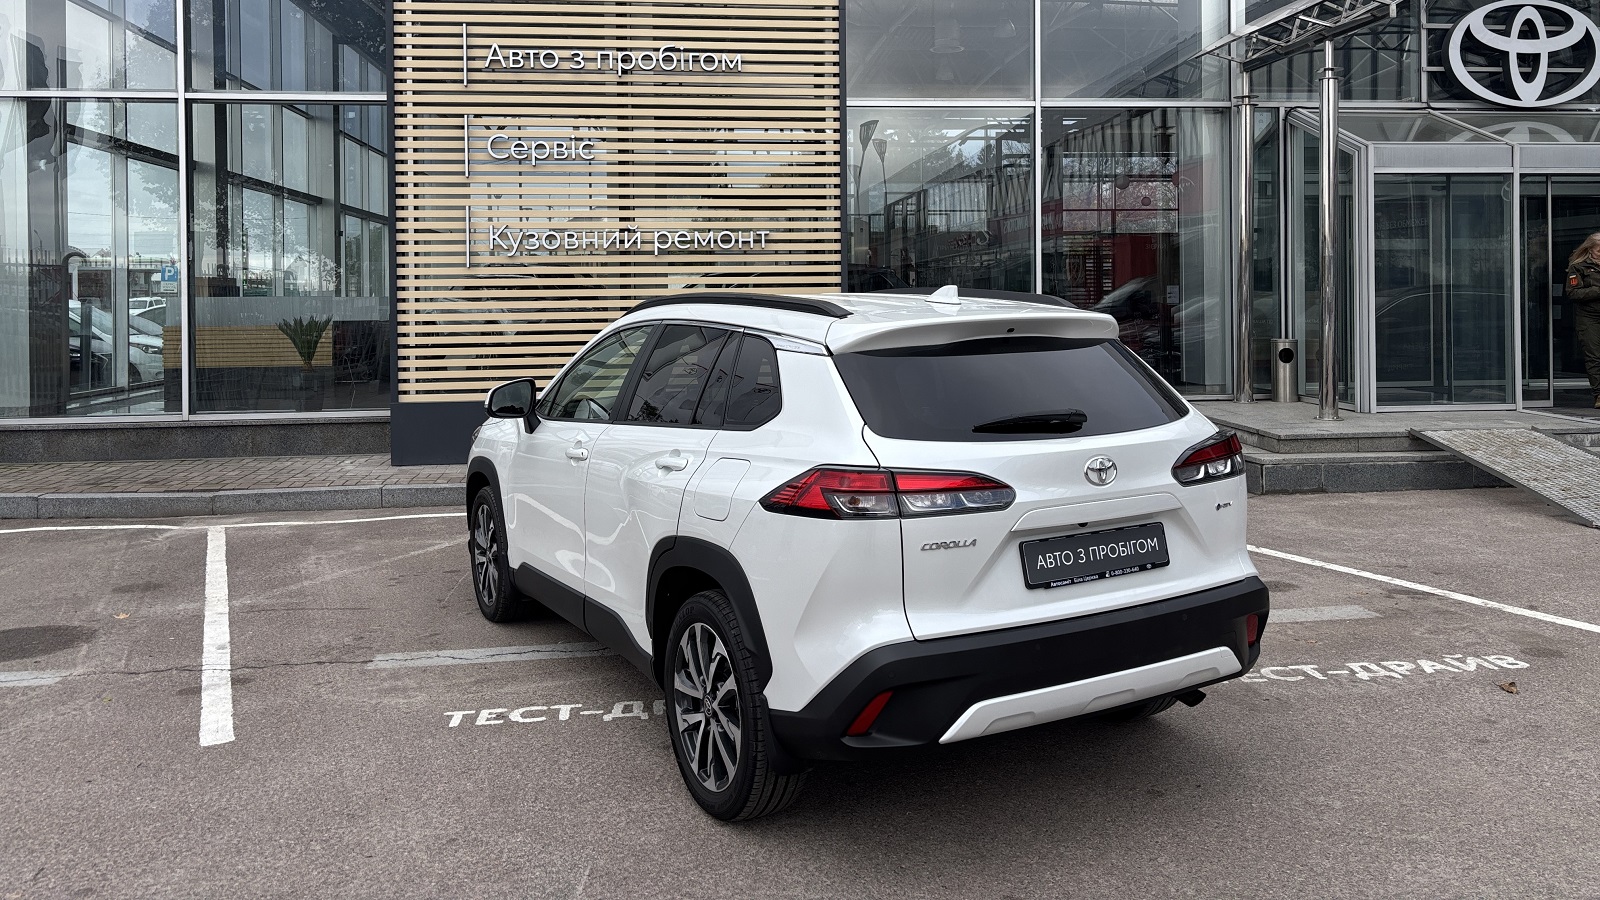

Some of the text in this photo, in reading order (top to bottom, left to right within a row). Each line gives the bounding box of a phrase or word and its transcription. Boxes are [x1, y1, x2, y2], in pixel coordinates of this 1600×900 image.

[484, 42, 743, 77] Авто з пробігом
[486, 133, 595, 166] Сервіс
[489, 224, 770, 256] Кузовний ремонт
[920, 538, 977, 551] COROLLA
[1037, 551, 1073, 569] АВТО
[1089, 537, 1159, 561] ПРОБІГОМ
[1222, 654, 1530, 684] ЕСТ-ДРАЙВ
